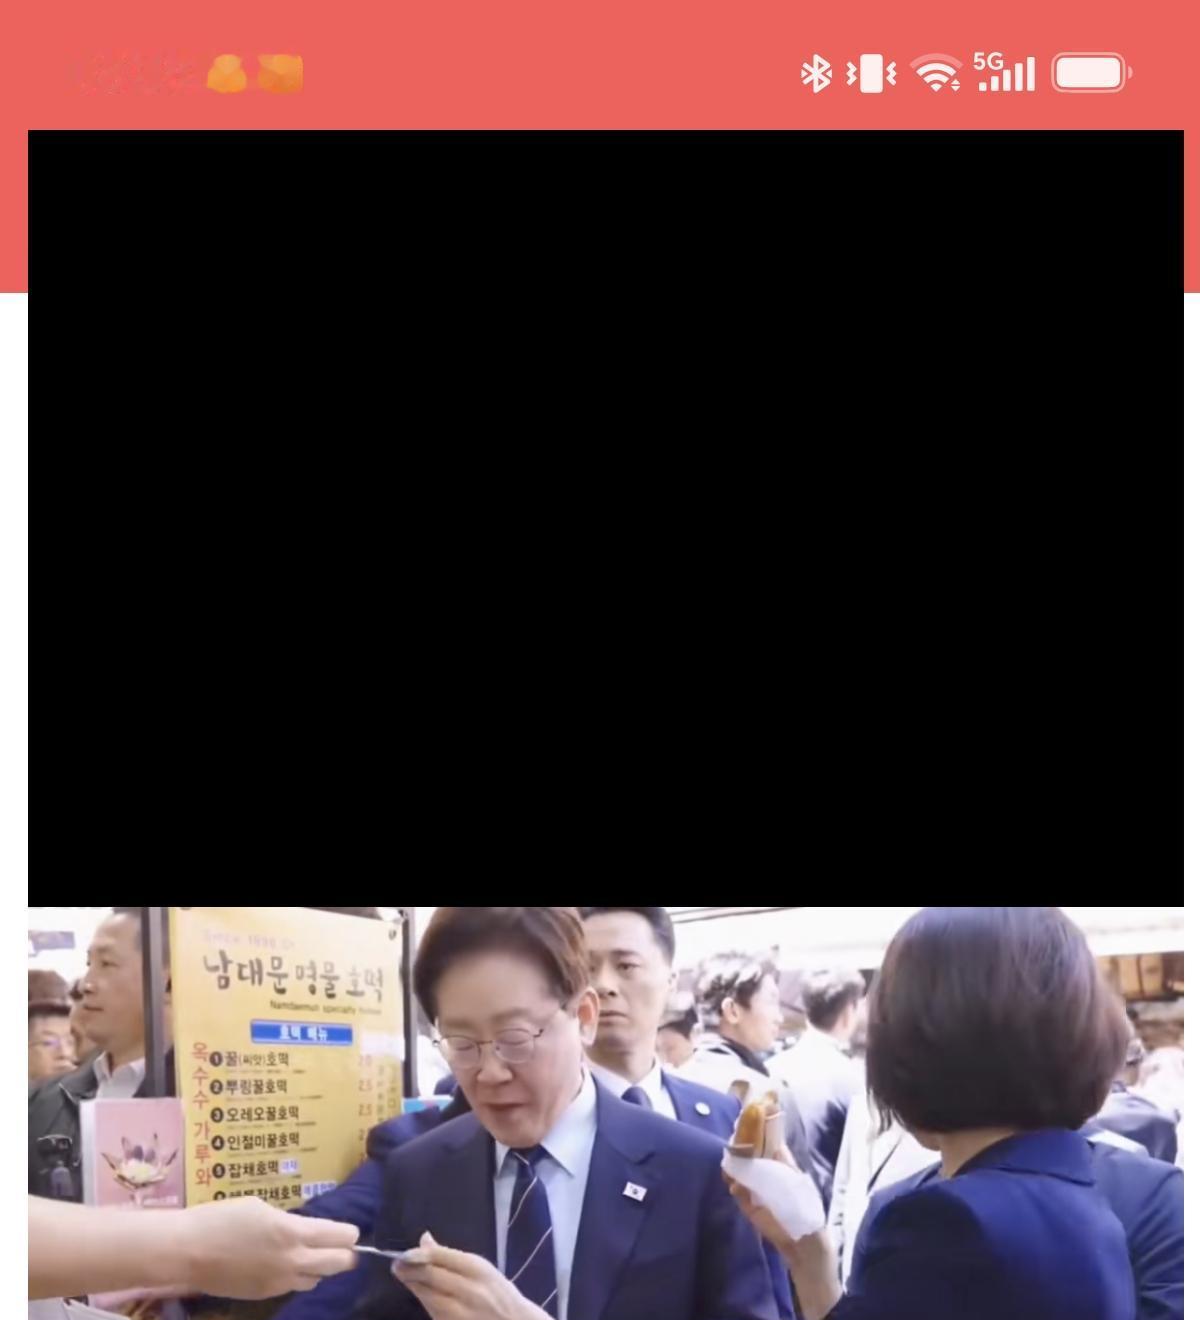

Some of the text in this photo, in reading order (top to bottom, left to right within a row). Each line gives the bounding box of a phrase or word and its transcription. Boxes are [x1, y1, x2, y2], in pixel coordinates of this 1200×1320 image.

[203, 949, 384, 1003] 남대문 명물 호떡
[226, 1106, 299, 1122] 오레오꿀호떡
[227, 1132, 300, 1151] 인절미꿀호떡
[228, 1160, 279, 1179] 잡채호떡
